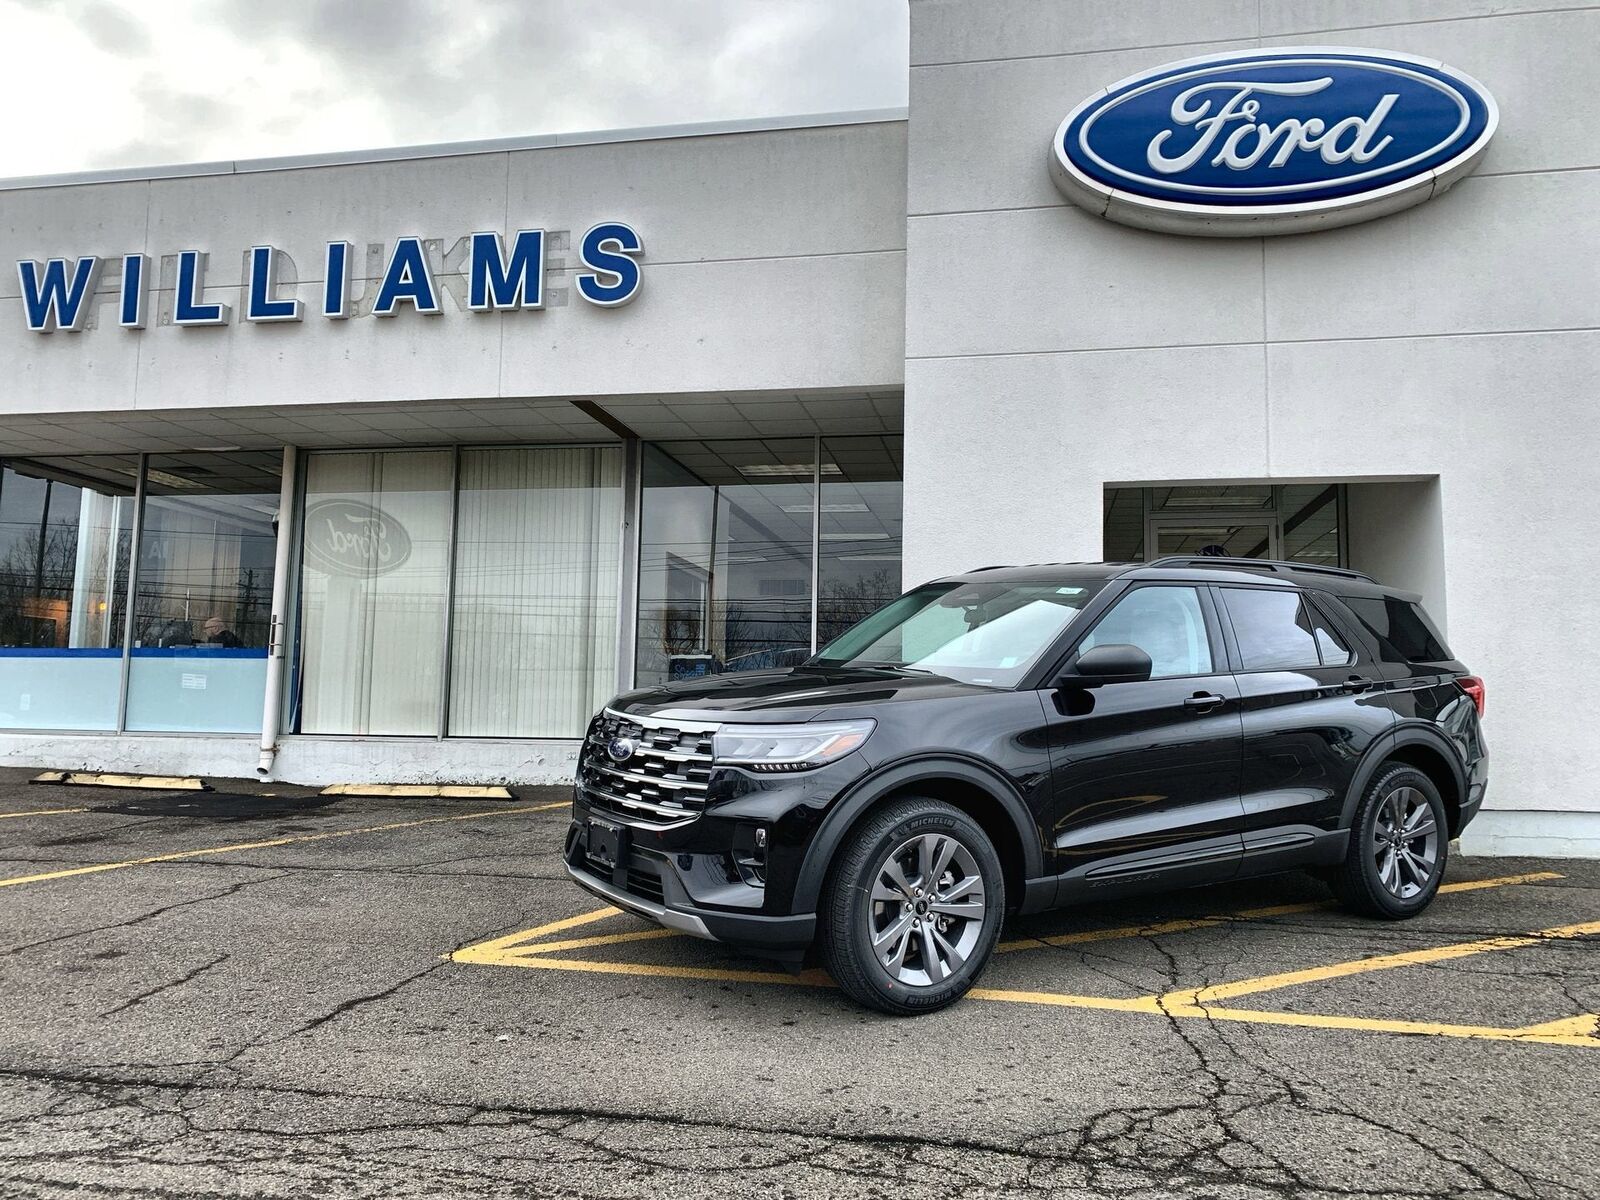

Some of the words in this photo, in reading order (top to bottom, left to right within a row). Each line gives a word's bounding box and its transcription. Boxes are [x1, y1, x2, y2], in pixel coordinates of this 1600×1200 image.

[1147, 76, 1400, 174] Ford
[17, 221, 643, 333] WILLIAMS
[910, 817, 954, 830] MICHELIN
